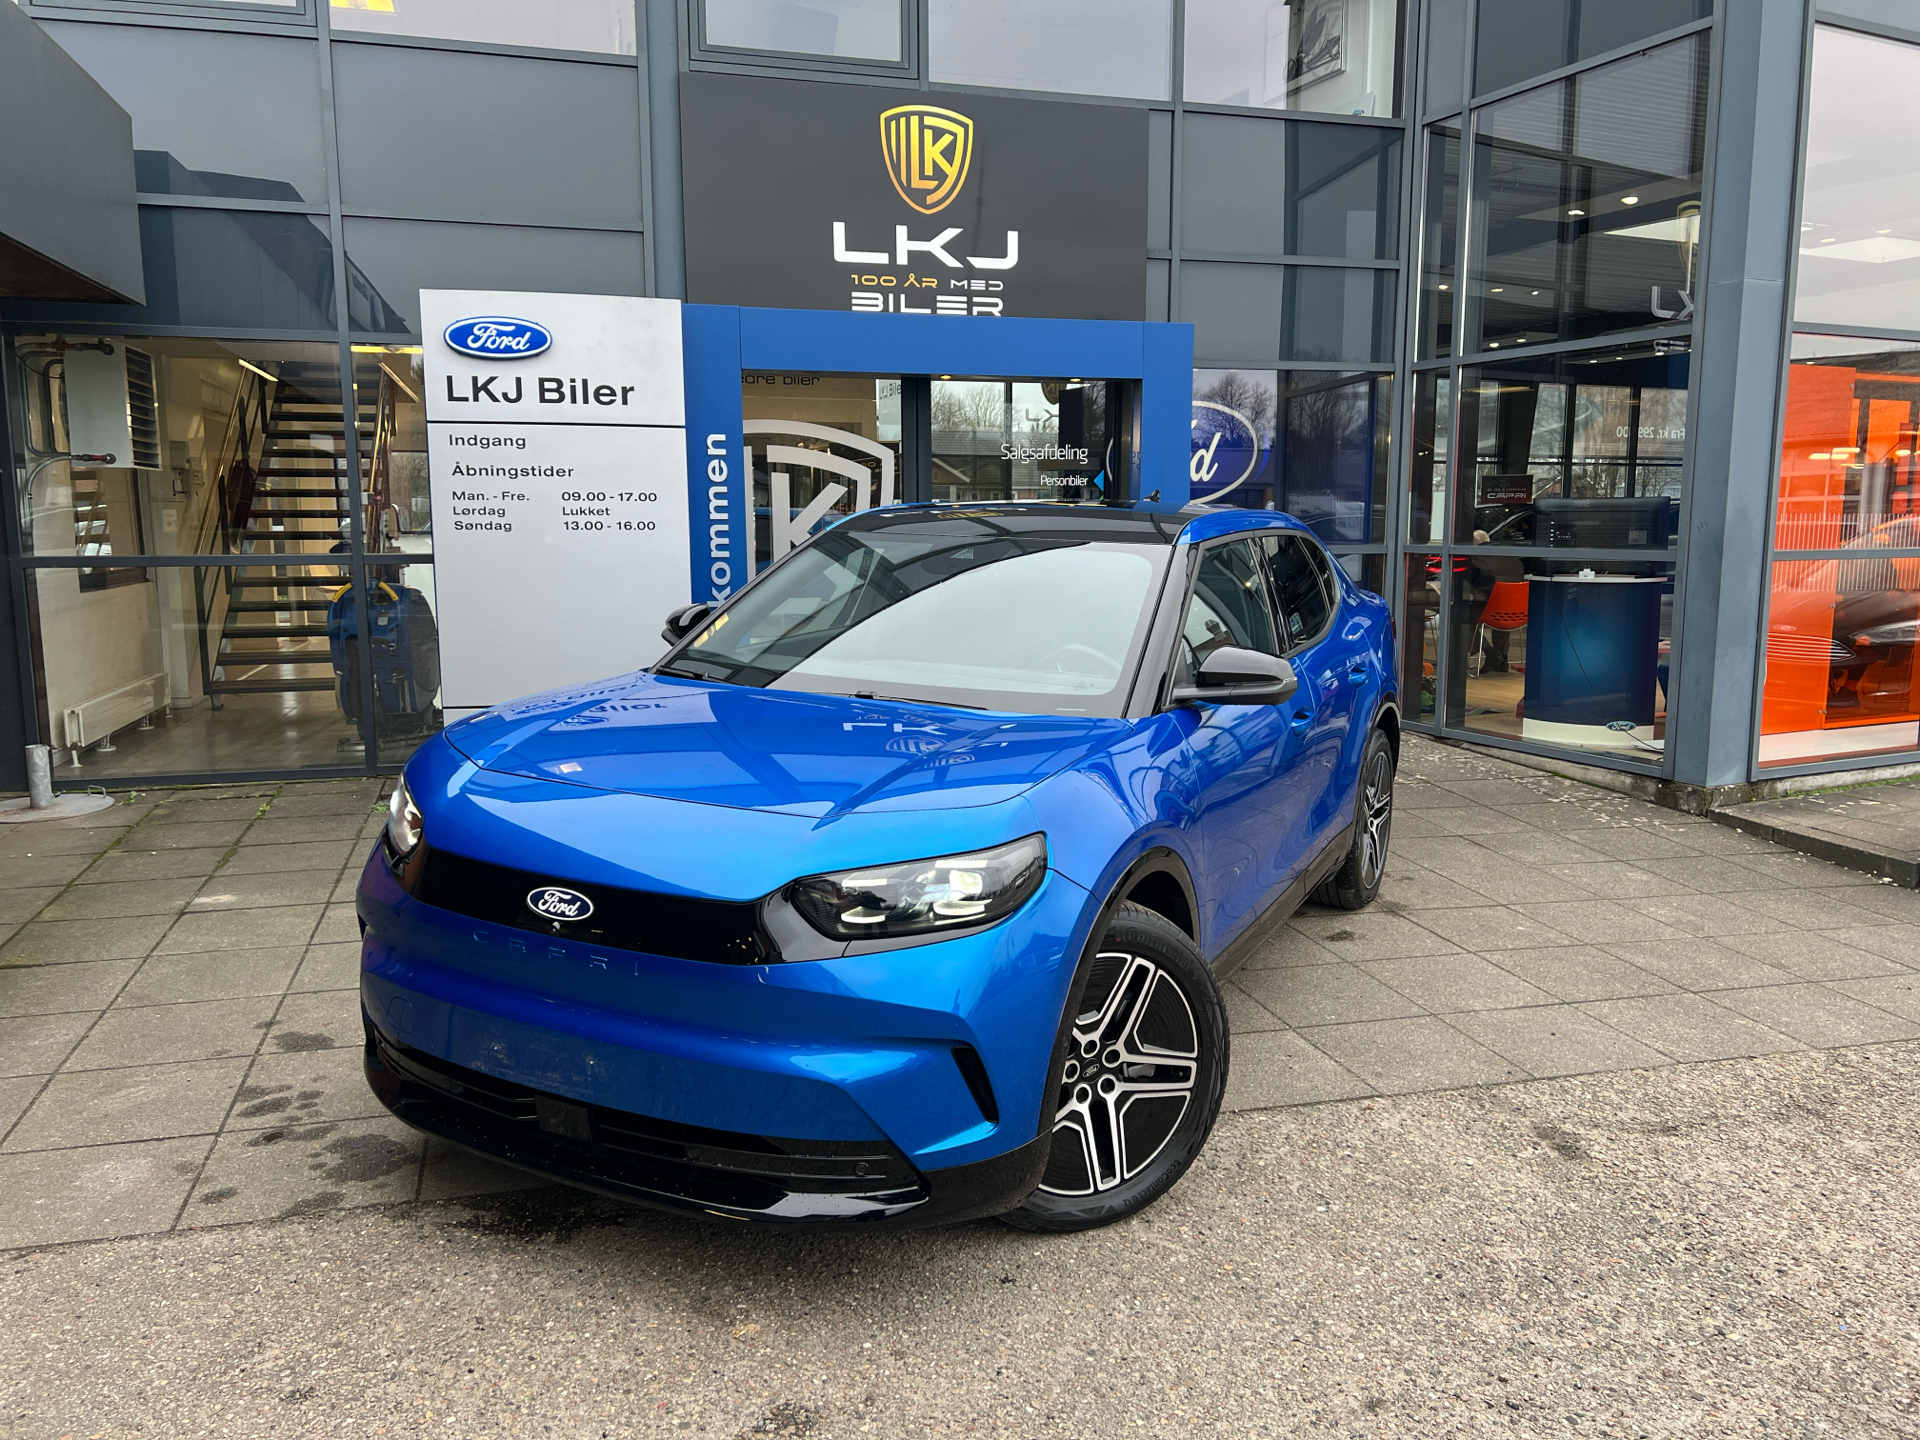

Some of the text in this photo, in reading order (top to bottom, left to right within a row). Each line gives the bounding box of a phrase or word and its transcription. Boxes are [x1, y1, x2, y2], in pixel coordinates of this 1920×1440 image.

[833, 221, 1019, 269] LKJ
[851, 273, 1004, 291] 100 ÅR MED
[851, 291, 1004, 317] BILER
[466, 322, 532, 351] Ford
[446, 375, 635, 406] LKJ Biler
[889, 381, 901, 397] Bile
[449, 434, 526, 449] Indgang
[1000, 443, 1089, 464] Salgsafdeling
[452, 461, 574, 479] Åbningstider
[1040, 474, 1089, 486] Personbiler
[452, 490, 490, 501] Man.
[501, 491, 530, 501] Fre.
[561, 491, 607, 502] 09.00
[617, 492, 657, 502] 17.00
[453, 505, 610, 517] Lørdag Lukket
[706, 433, 731, 608] kommen
[454, 520, 512, 532] Søndag
[563, 521, 603, 531] 13.00
[616, 521, 656, 531] 16.00
[537, 889, 580, 917] Ford
[1138, 1159, 1182, 1198] EcoContact
